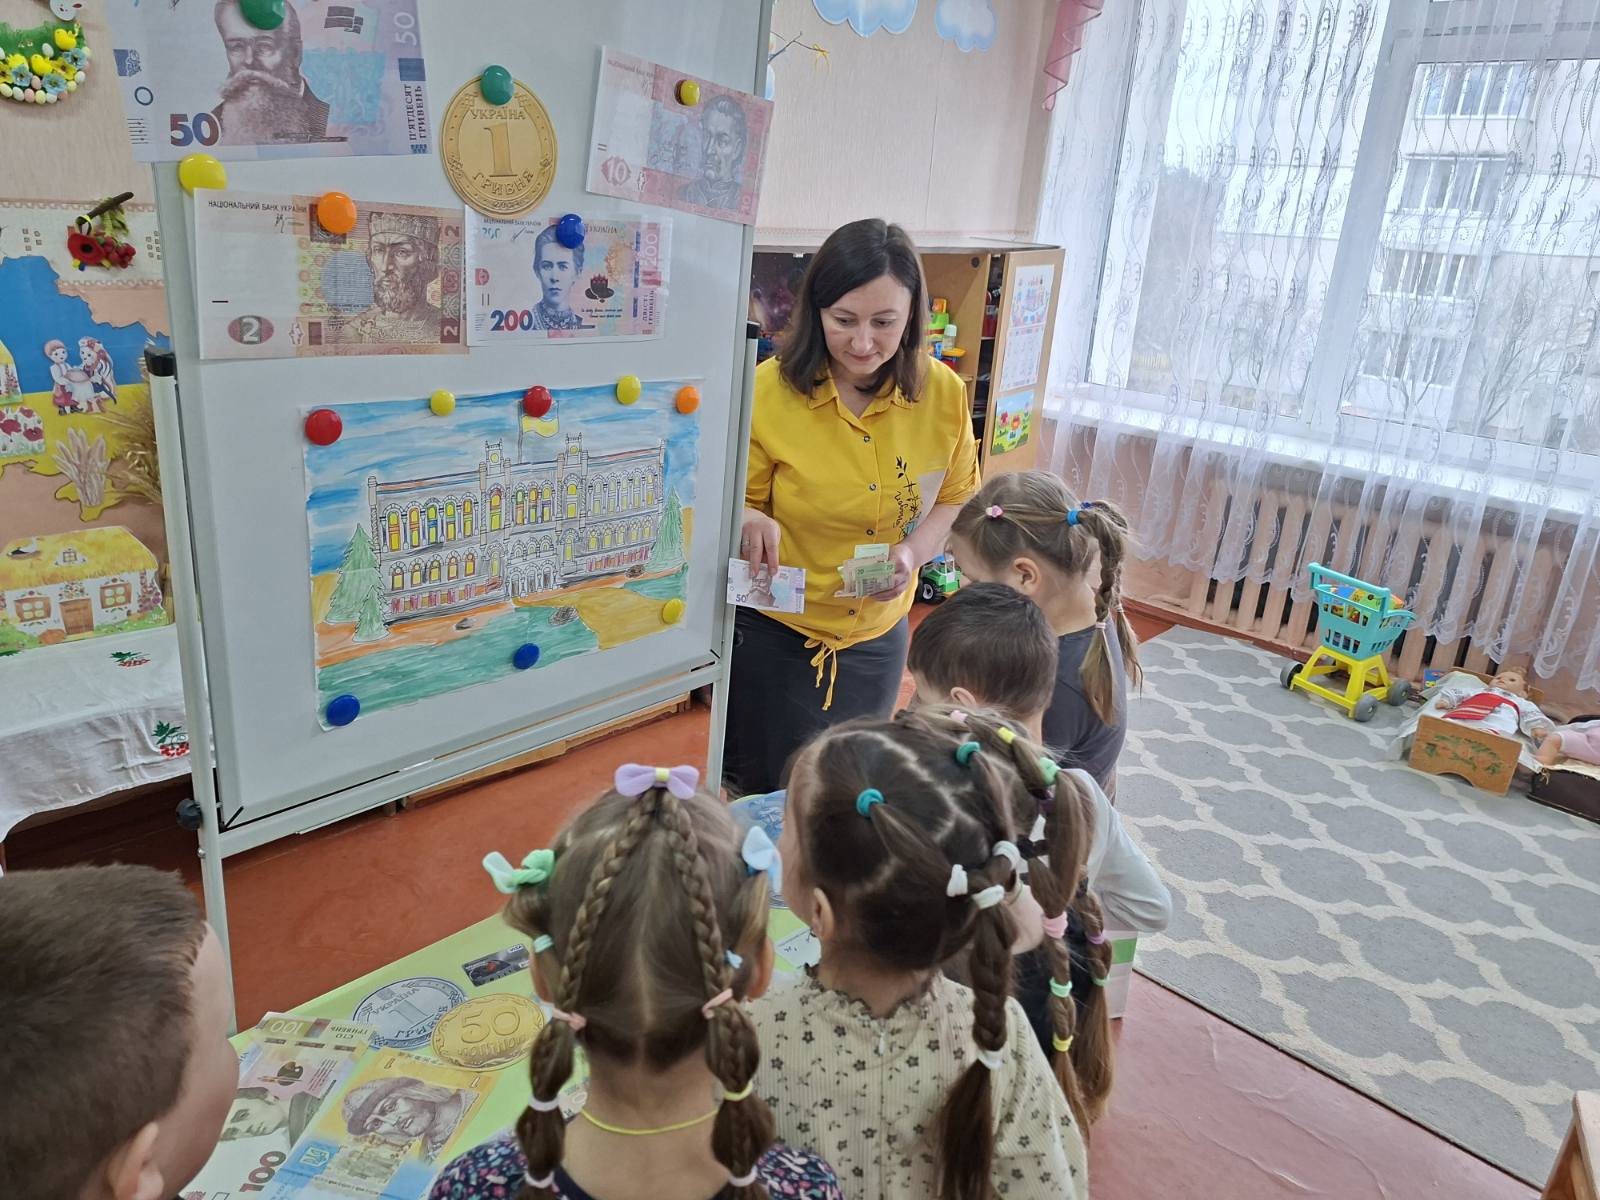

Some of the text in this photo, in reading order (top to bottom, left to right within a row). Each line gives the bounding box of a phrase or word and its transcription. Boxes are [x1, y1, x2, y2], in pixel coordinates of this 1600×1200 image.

[393, 11, 418, 46] 50
[404, 84, 417, 141] П'ЯТДЕСЯТ
[415, 86, 427, 139] ГРИВЕНЬ
[470, 107, 526, 120] УКРАЇНА
[170, 112, 220, 147] 50
[483, 121, 518, 178] 1
[472, 170, 534, 196] ГРИВНЯ
[607, 156, 628, 185] 10
[208, 200, 260, 210] НАЦІОНАЛЬНИЙ
[261, 203, 279, 211] БАНК
[447, 225, 460, 238] 2
[242, 317, 260, 342] 2
[443, 326, 459, 337] 2
[490, 309, 533, 332] 200
[735, 594, 747, 603] 50
[270, 1019, 301, 1034] 100
[388, 999, 435, 1030] 1
[461, 1008, 520, 1044] 50
[239, 1151, 287, 1192] 100
